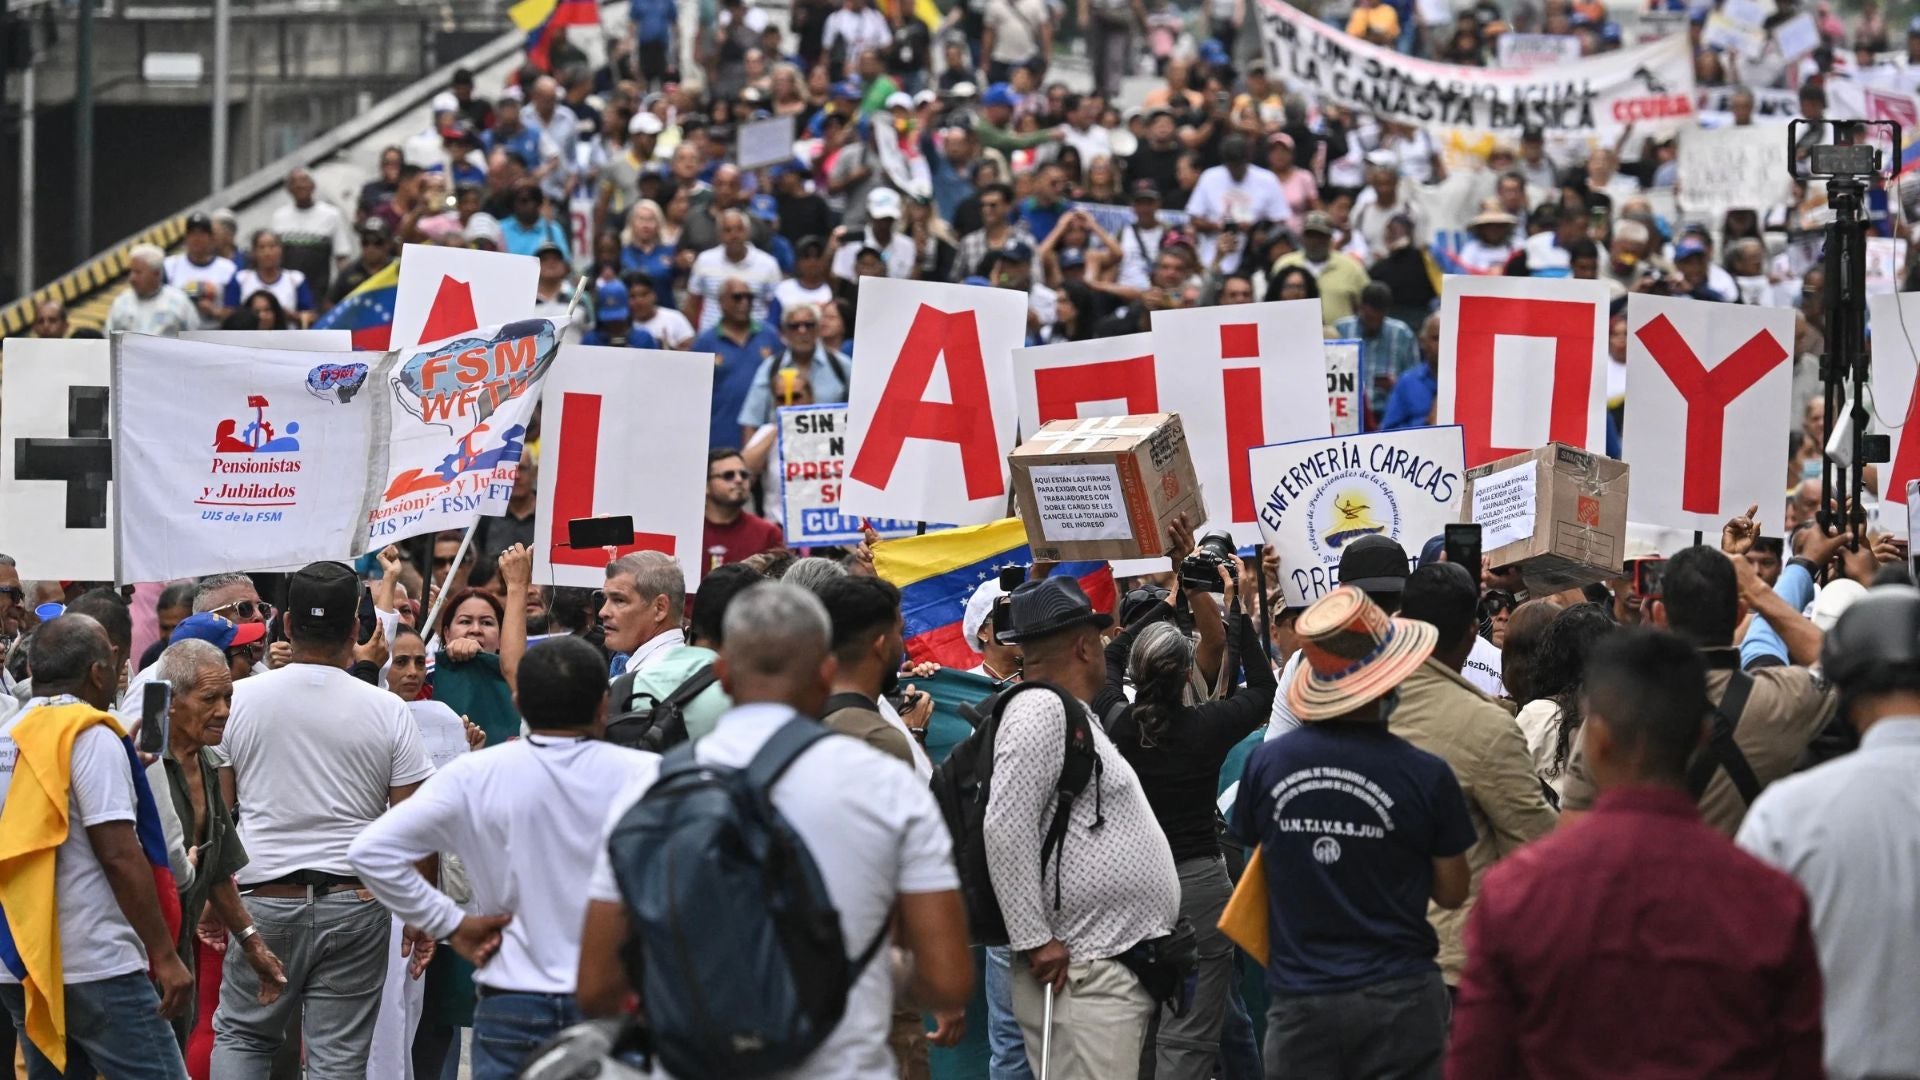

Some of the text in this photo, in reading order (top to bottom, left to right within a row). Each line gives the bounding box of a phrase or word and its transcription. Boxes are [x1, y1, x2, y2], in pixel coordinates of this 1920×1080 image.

[421, 336, 537, 390] FSM
[849, 302, 1005, 501] A
[1634, 312, 1789, 515] Y
[795, 414, 834, 434] SIN
[211, 457, 301, 474] Pensionistas
[1360, 470, 1369, 478] de
[456, 480, 466, 495] y
[1261, 441, 1361, 532] ENFERMERÍA
[1370, 443, 1458, 503] CARACAS
[1370, 474, 1380, 484] la
[1502, 480, 1511, 488] LAS
[200, 483, 296, 500] y Jubilados
[1043, 494, 1094, 502] TRABAJADORES
[1309, 470, 1357, 510] Profesionales
[1508, 487, 1517, 495] QUE
[441, 494, 482, 513] FSM
[1482, 498, 1511, 510] AGUINALDO
[201, 510, 282, 522] UIS de la FSM
[1475, 508, 1504, 522] CALCULADO
[1505, 505, 1516, 513] CON
[1504, 510, 1527, 520] MENSUAL
[1306, 521, 1319, 551] Colegio
